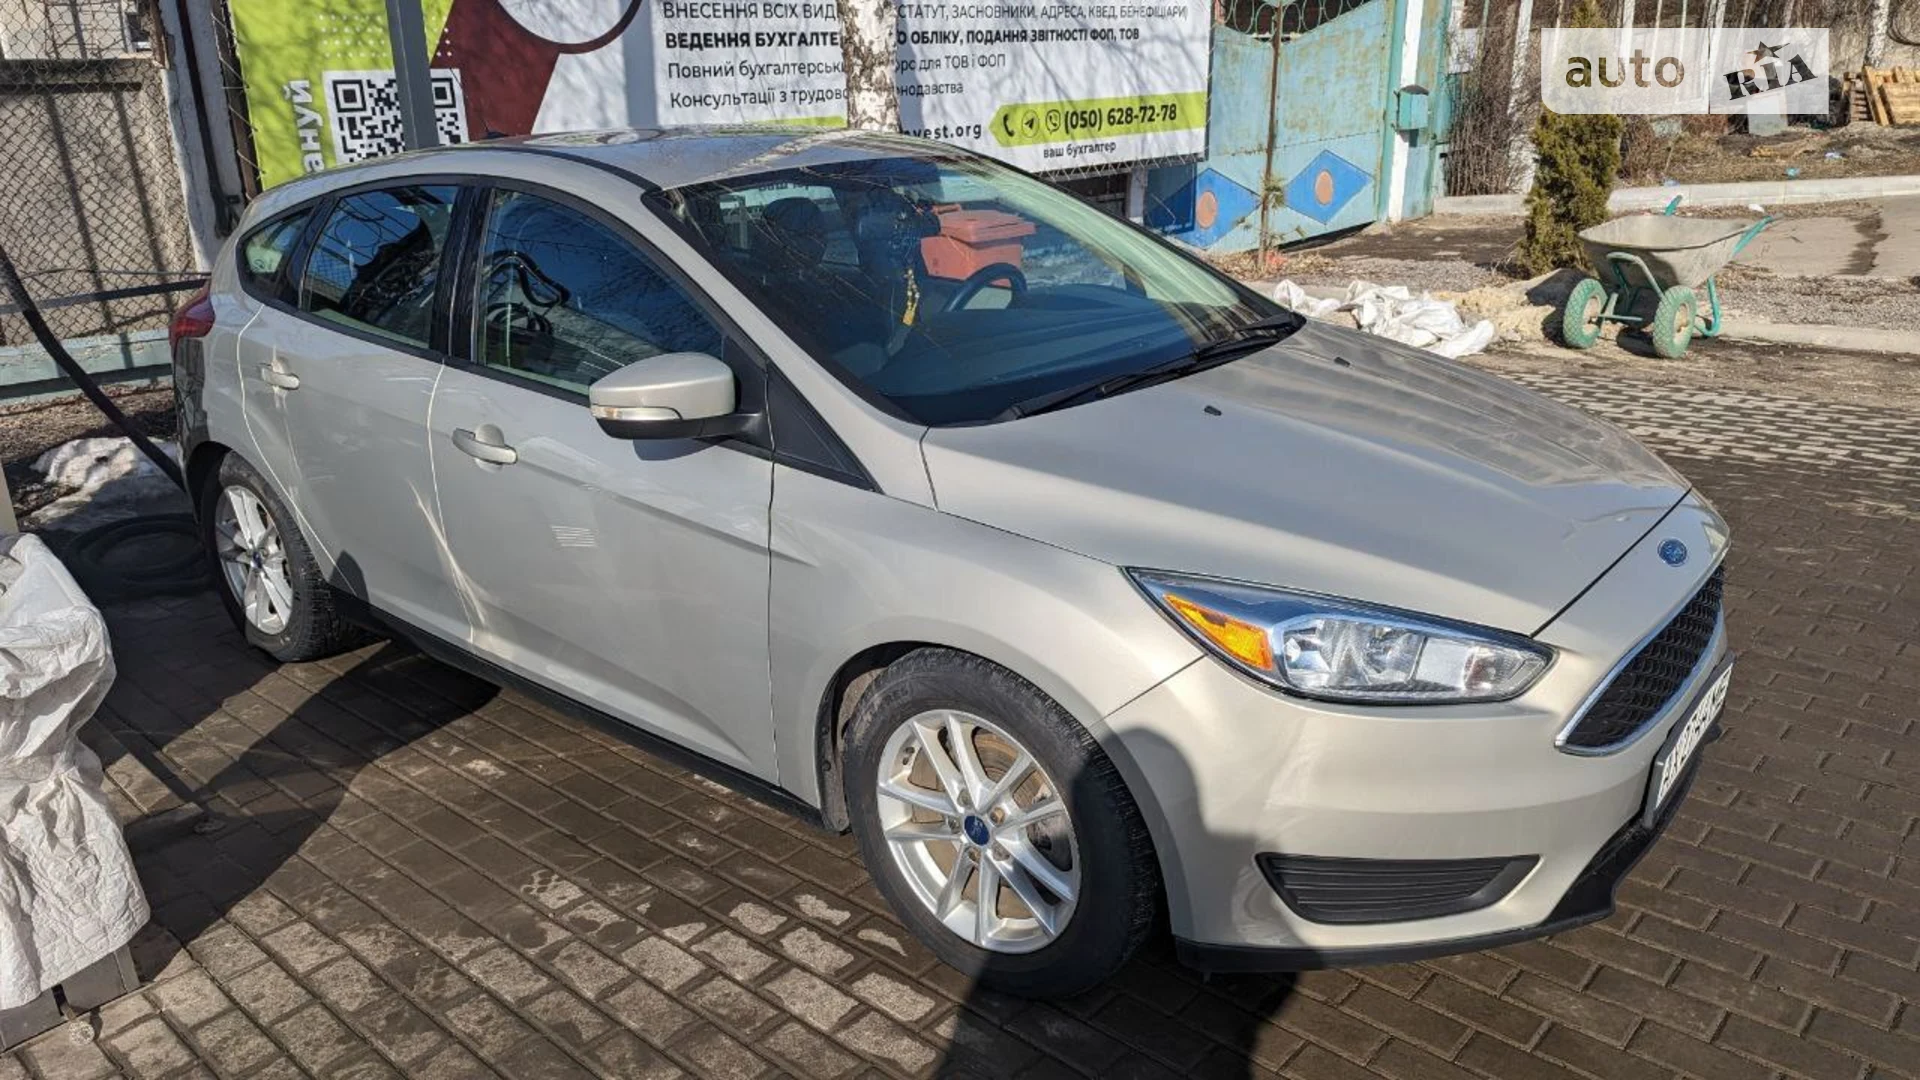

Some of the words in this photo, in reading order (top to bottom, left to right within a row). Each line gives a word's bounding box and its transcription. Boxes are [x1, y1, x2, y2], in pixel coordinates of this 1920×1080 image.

[663, 2, 758, 19] ВНЕСЕННЯ
[763, 2, 799, 19] ВСІХ
[803, 3, 840, 21] ВИД
[952, 5, 1038, 20] ЗАСНОВНИКИ,
[1040, 5, 1087, 20] АДРЕСА,
[1088, 5, 1118, 19] КВЕД,
[665, 32, 750, 50] ВЕДЕННЯ
[911, 31, 964, 45] ОБЛІКУ,
[966, 29, 1028, 45] ПОДАННЯ
[1031, 28, 1088, 42] ЗВІТНОСТІ
[1090, 28, 1117, 42] ФОП,
[1119, 28, 1140, 40] ТОВ
[668, 61, 735, 79] Повний
[739, 60, 844, 82] бухгалтерськ
[919, 59, 942, 73] для
[944, 56, 969, 69] ТОВ
[978, 53, 1006, 68] ФОП
[671, 87, 776, 110] Консультації
[780, 91, 787, 103] з
[790, 88, 849, 106] трудово
[1064, 108, 1102, 134] (050)
[1107, 104, 1177, 126] 628-72-78
[1043, 147, 1064, 158] ваш
[1066, 141, 1116, 158] бухгалтер
